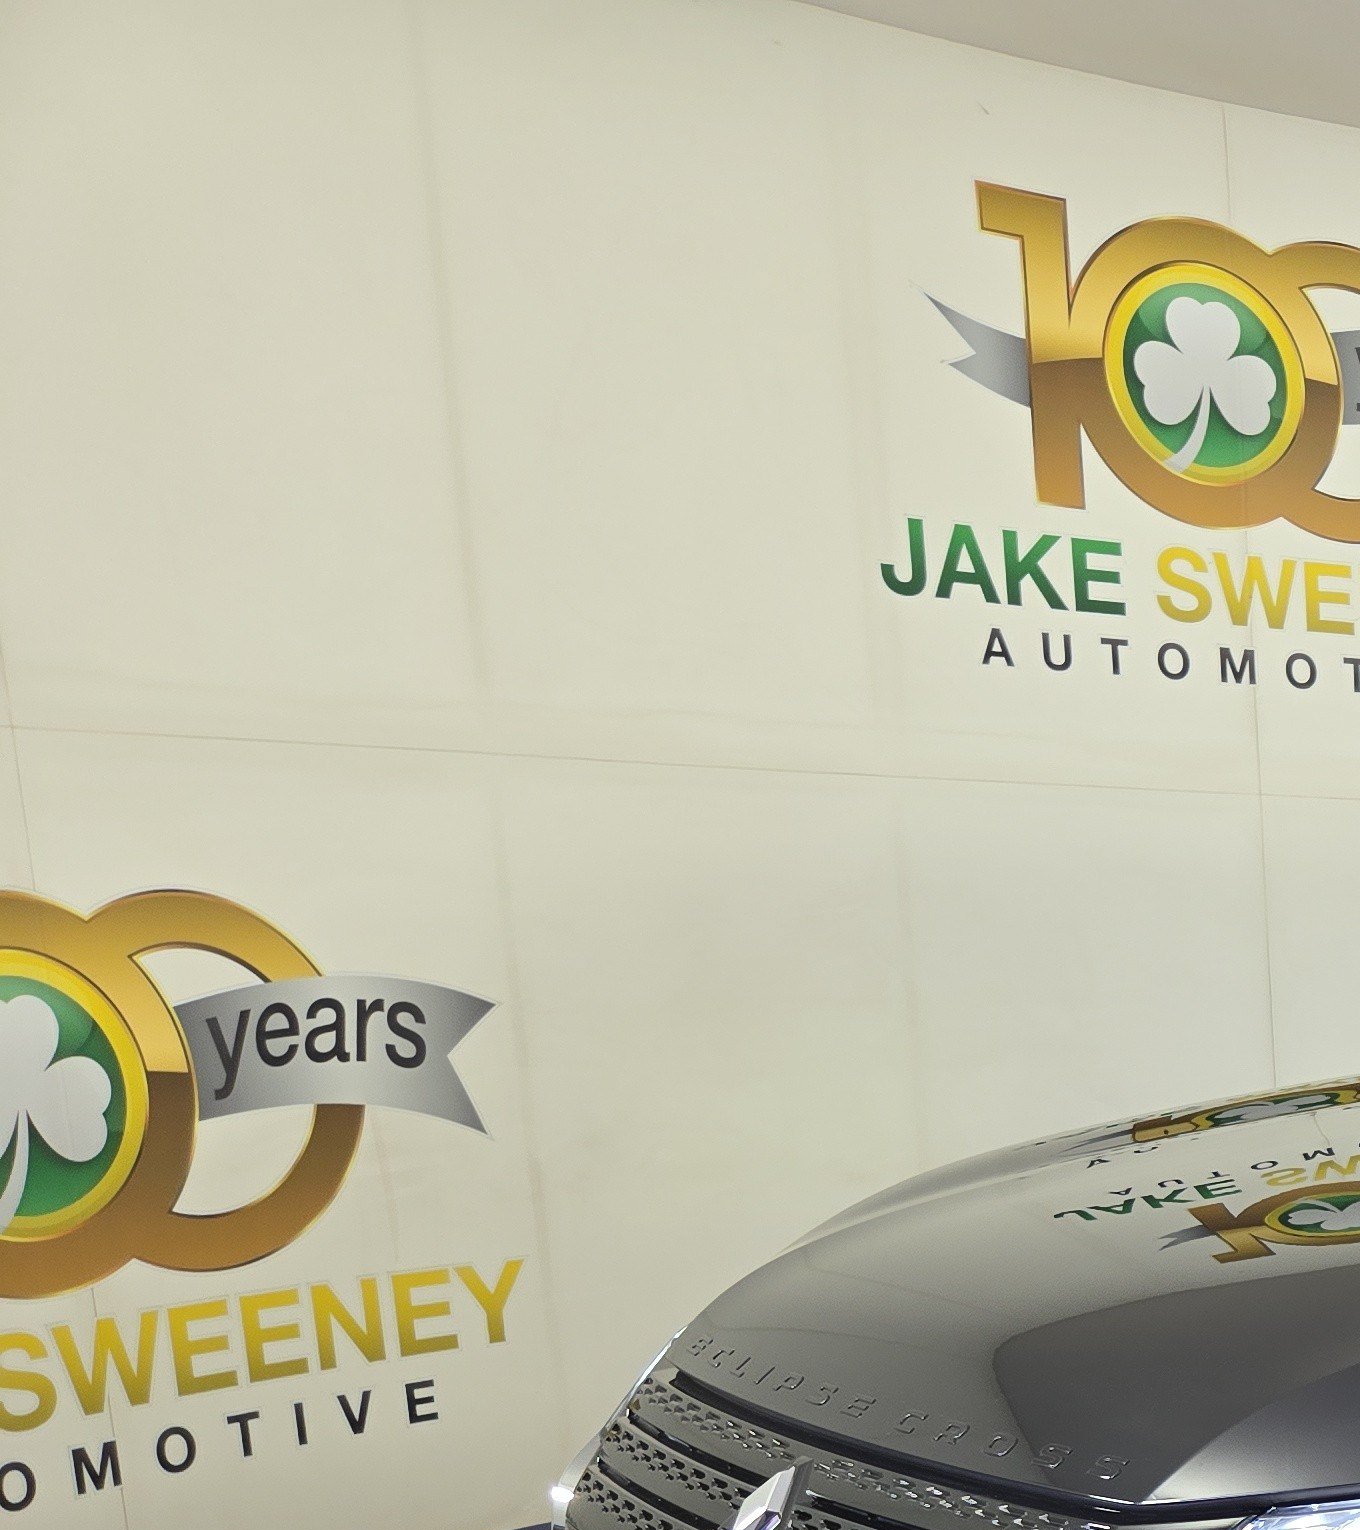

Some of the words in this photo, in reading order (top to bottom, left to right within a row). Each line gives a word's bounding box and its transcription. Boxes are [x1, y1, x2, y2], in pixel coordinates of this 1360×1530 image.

[880, 516, 1127, 617] JAKE
[206, 996, 428, 1100] years
[0, 1259, 525, 1432] SWEENEY
[685, 1335, 877, 1420] ECLIPSE
[894, 1410, 1132, 1481] CROSS
